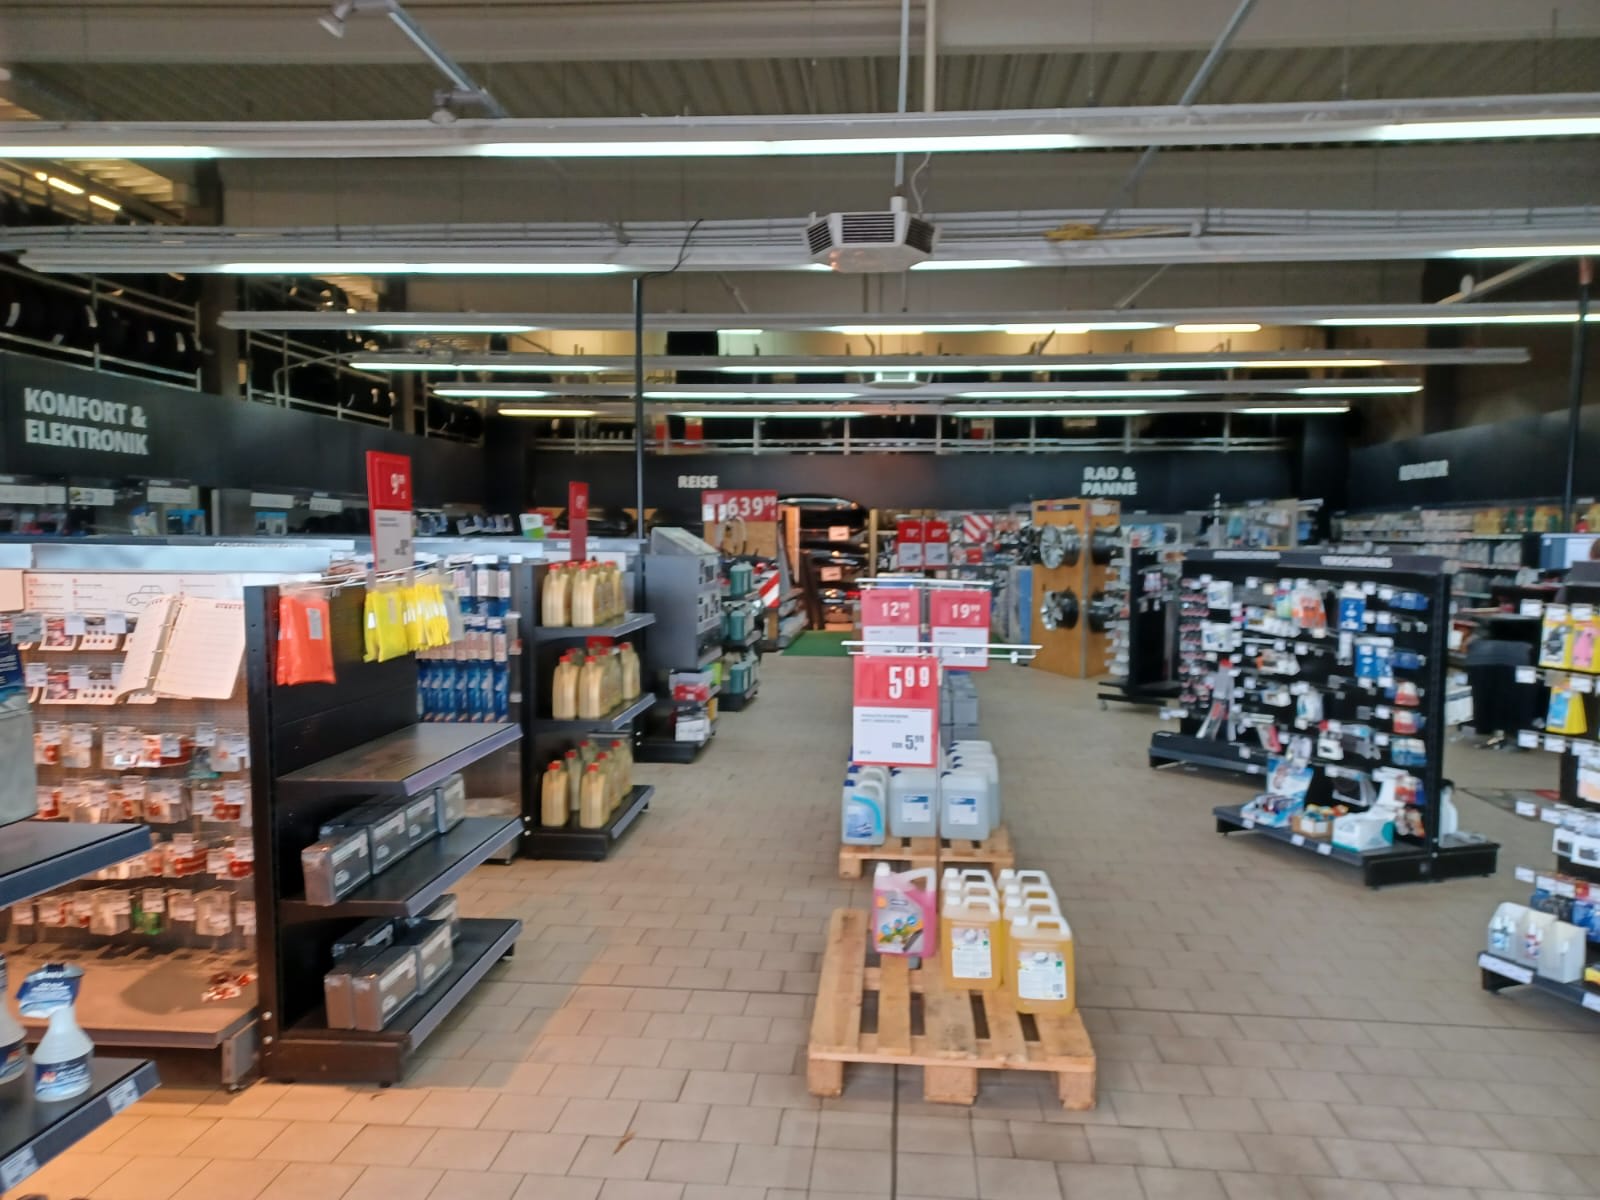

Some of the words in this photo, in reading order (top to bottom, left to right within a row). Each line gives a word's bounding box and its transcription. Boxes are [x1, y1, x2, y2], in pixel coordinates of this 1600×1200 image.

[24, 387, 128, 425] KOMFORT
[131, 405, 147, 428] &
[25, 419, 149, 455] ELEKTRONIK
[1083, 466, 1119, 480] RAD
[1121, 466, 1136, 480] &
[678, 475, 718, 488] REISE
[1081, 482, 1137, 495] PANNE
